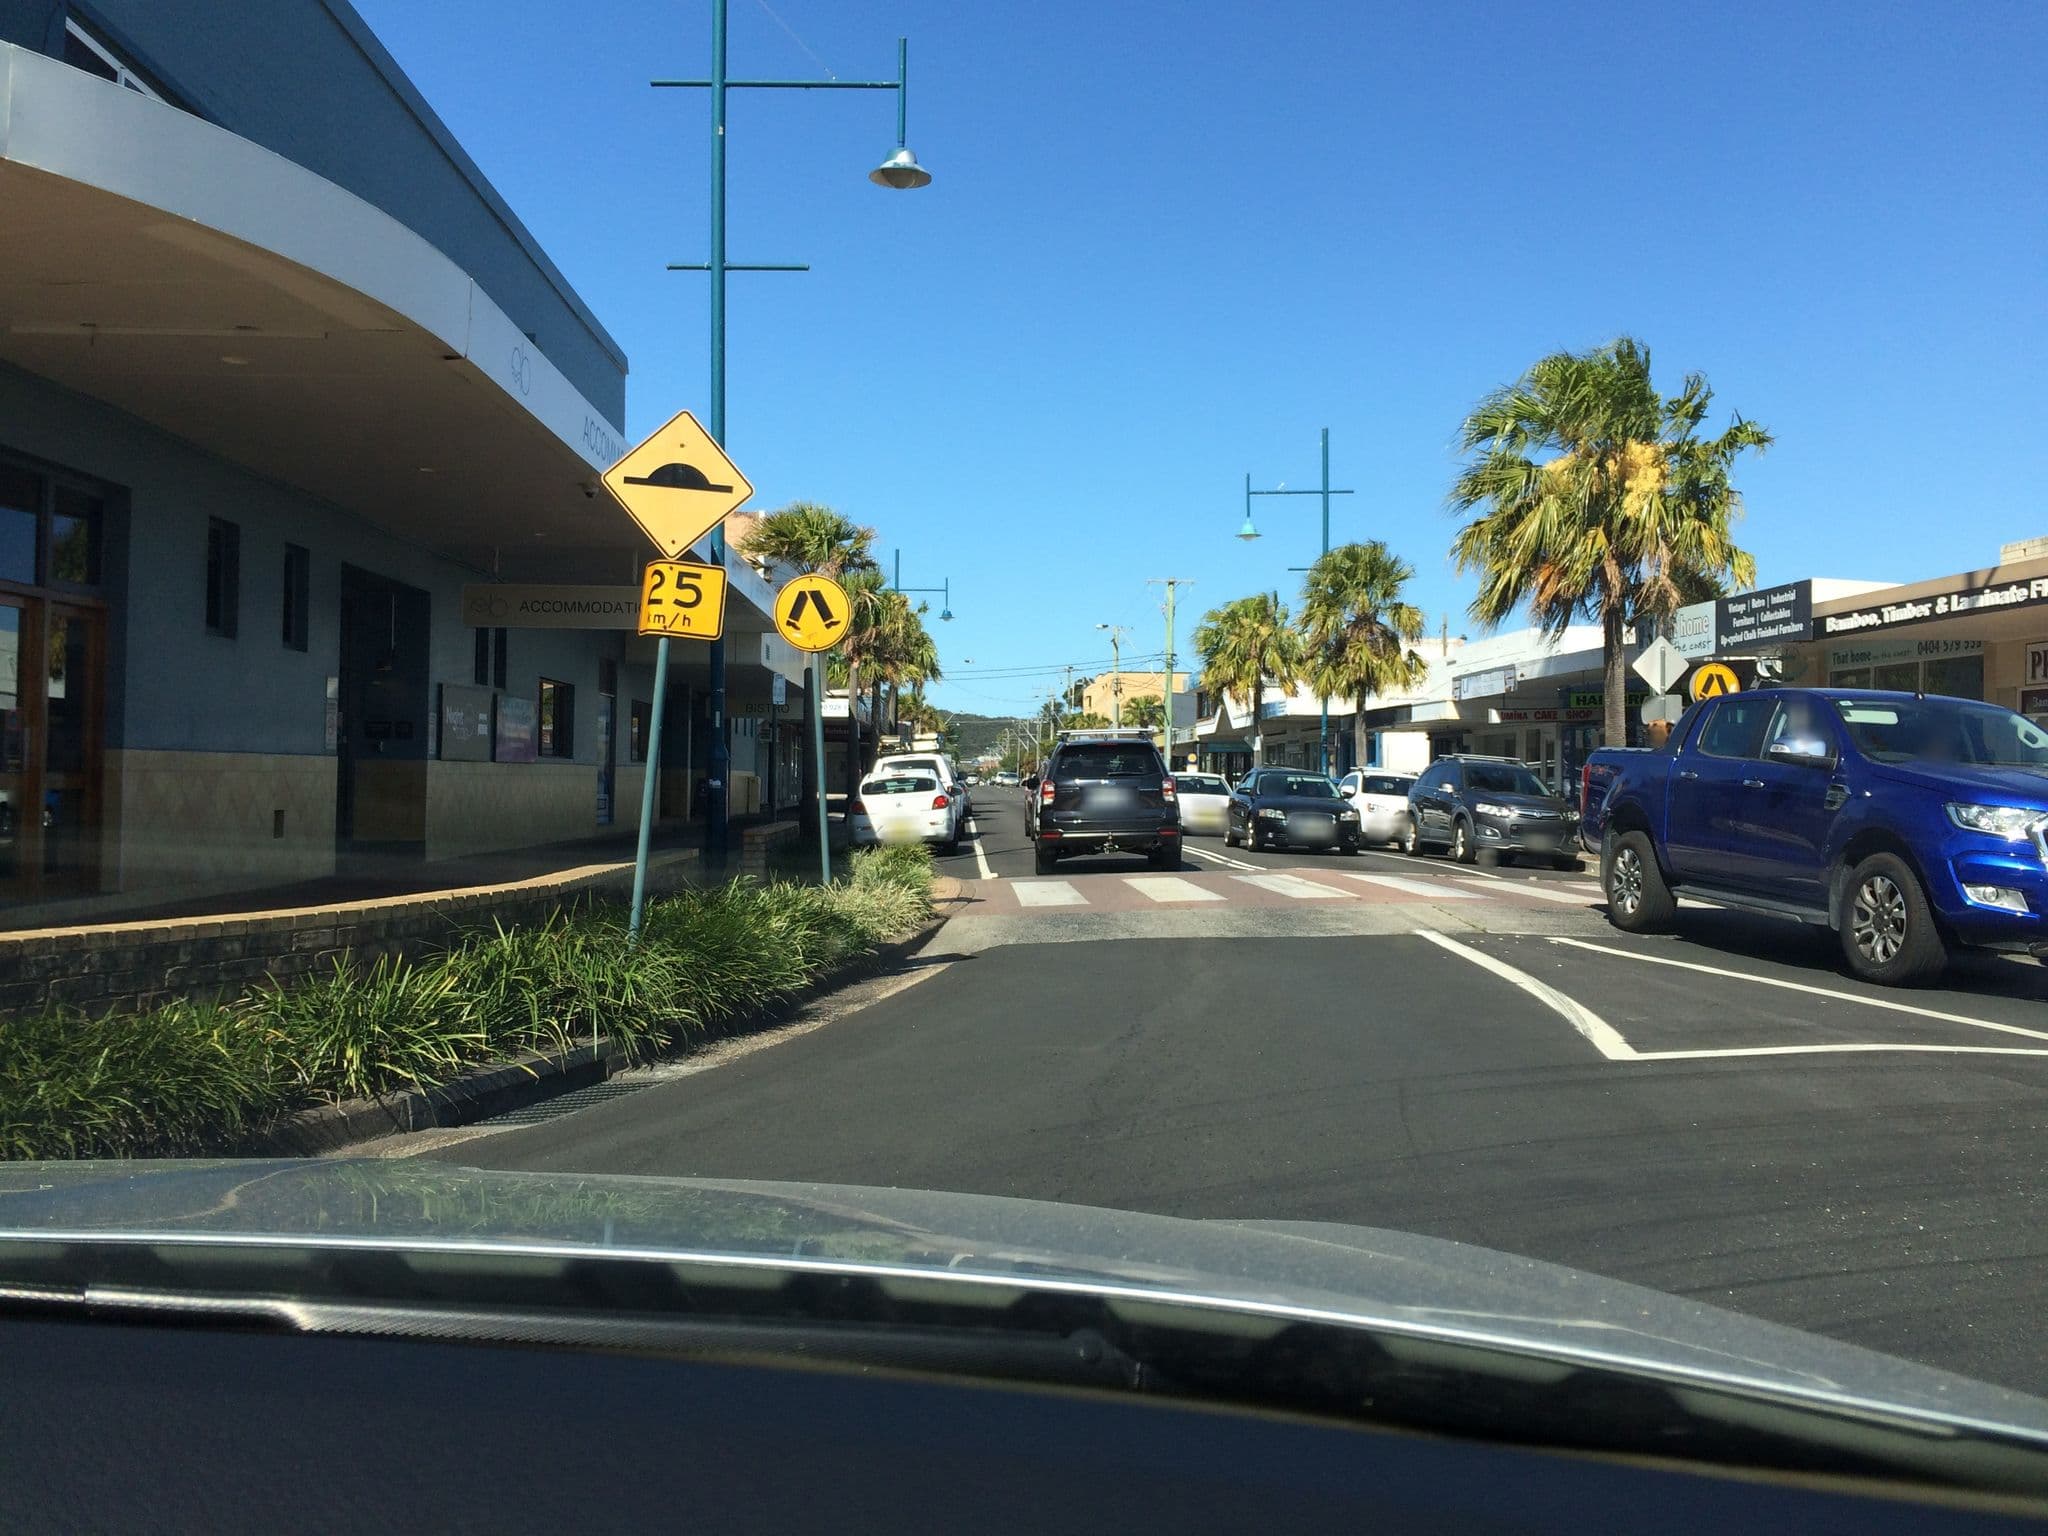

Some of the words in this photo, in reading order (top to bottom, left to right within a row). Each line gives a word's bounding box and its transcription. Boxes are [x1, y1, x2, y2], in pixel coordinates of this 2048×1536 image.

[648, 569, 702, 609] 25
[1770, 589, 1796, 605] Industrial
[1826, 612, 1882, 632] Bamboo,
[1881, 602, 1932, 623] Timber
[1935, 596, 1949, 614] &
[1951, 584, 2028, 612] Laminate
[1680, 613, 1710, 638] home
[1733, 616, 1755, 628] Furniture
[1779, 622, 1804, 635] Furniture
